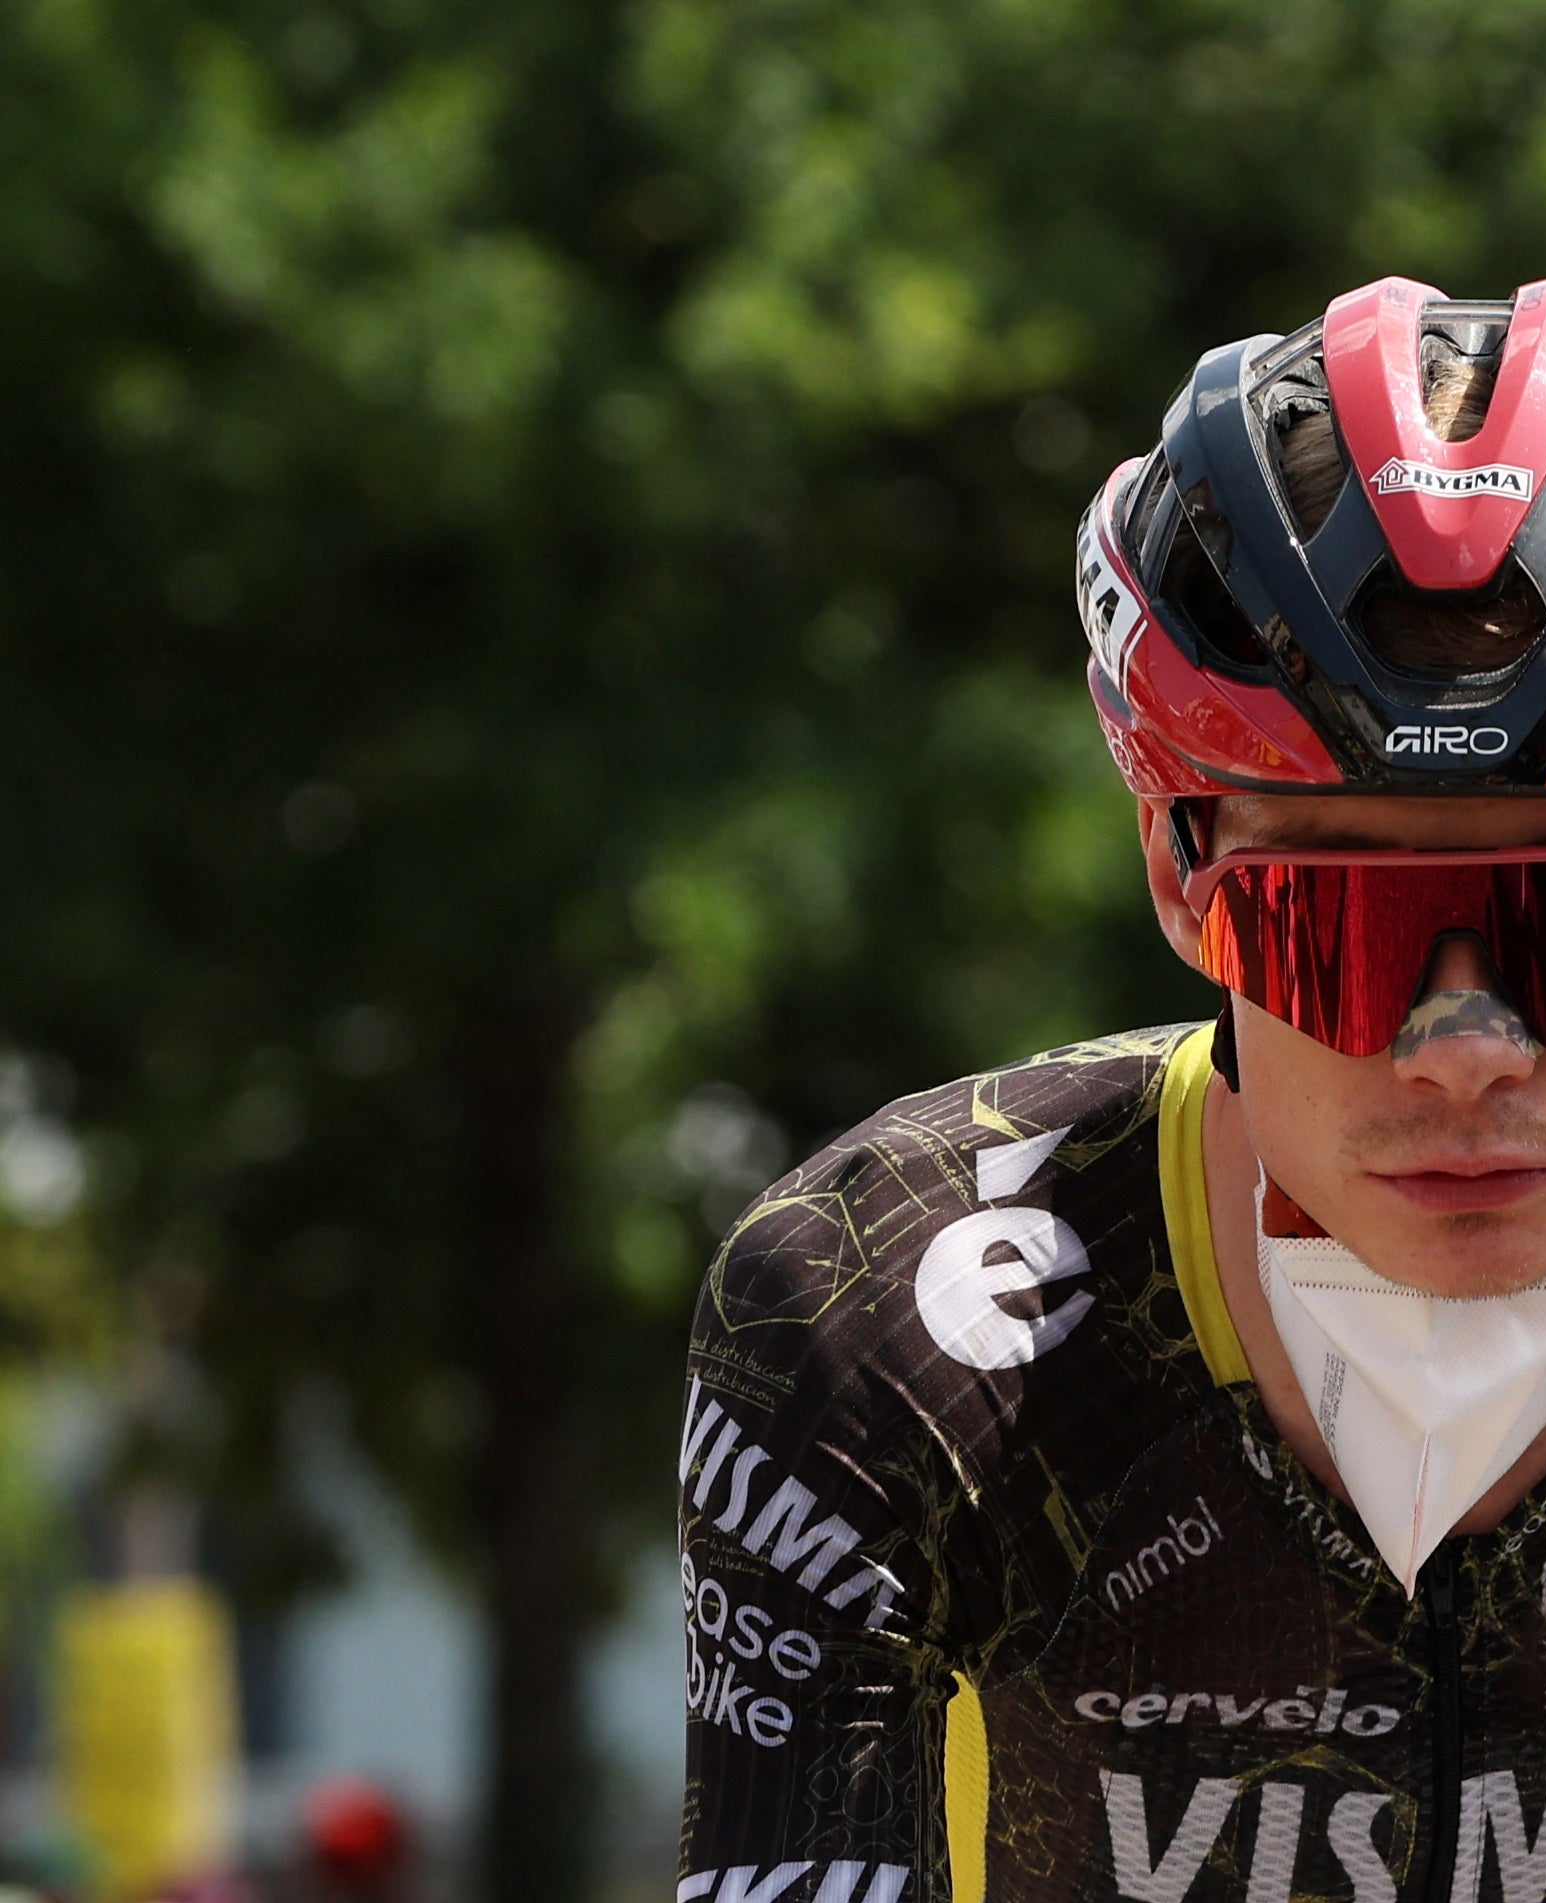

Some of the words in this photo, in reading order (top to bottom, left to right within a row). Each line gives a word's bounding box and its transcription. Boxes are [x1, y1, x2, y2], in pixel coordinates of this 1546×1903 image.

[1413, 470, 1521, 491] BYGMA
[1386, 726, 1508, 754] GIRO
[679, 1372, 905, 1627] VISMA
[1105, 1495, 1224, 1611] nimbl
[680, 1545, 821, 1681] ease
[1075, 1686, 1401, 1736] cervélo
